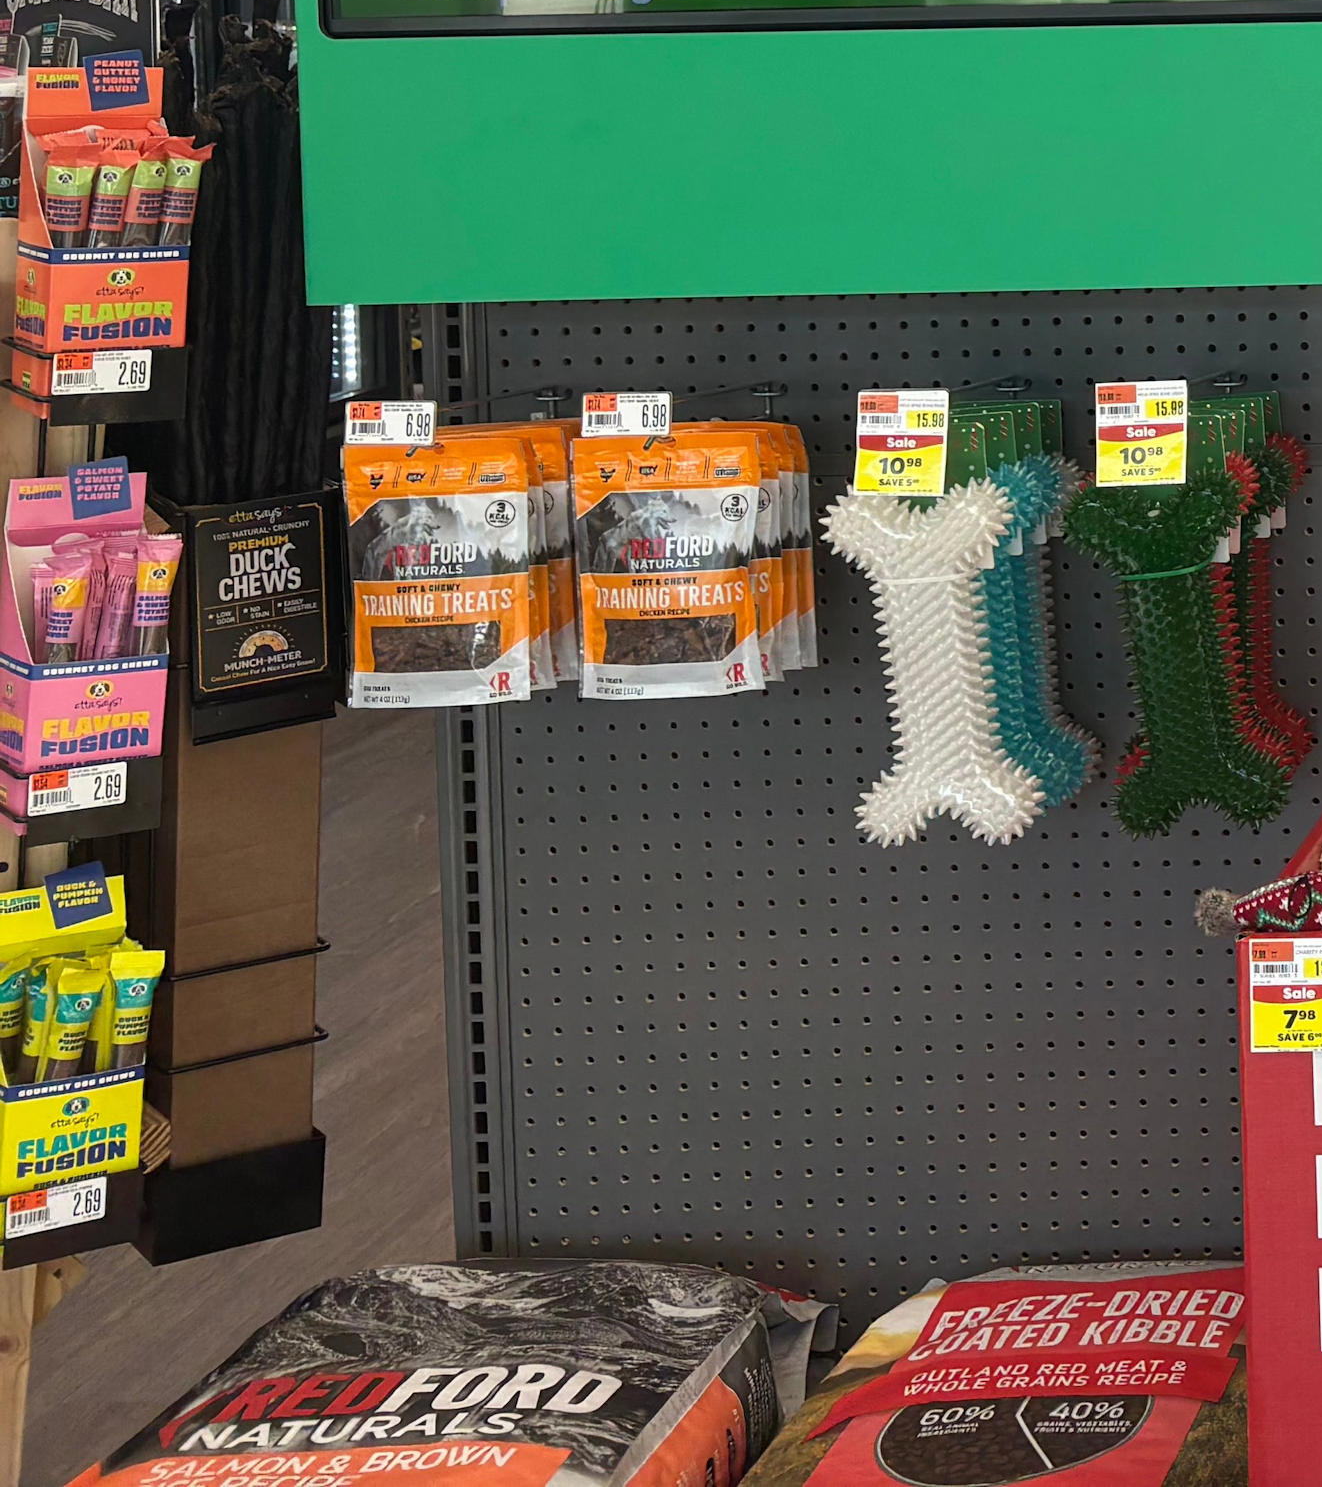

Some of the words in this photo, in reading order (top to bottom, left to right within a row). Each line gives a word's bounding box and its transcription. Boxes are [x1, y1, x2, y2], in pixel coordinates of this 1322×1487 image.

[64, 302, 173, 324] FLAVOR
[63, 317, 172, 342] FUSION
[118, 358, 146, 386] 2.69
[406, 415, 430, 438] 6.98
[917, 413, 944, 428] 15.98
[887, 437, 916, 449] Sale
[230, 543, 296, 576] DUCK
[219, 567, 301, 601] CHEWS
[363, 593, 435, 617] TRAINING
[443, 588, 513, 614] TREATS
[1283, 987, 1315, 1000] Sale
[73, 1190, 101, 1218] 2.69
[928, 1290, 1245, 1342] FREEZE-DRIED
[908, 1323, 1075, 1362] COATED
[1080, 1320, 1232, 1349] KIBBLE
[903, 1379, 991, 1398] WHOLE
[997, 1376, 1091, 1391] GRAINS
[1097, 1373, 1183, 1387] RECIPE
[911, 1364, 1035, 1385] OUTLAND
[1040, 1363, 1089, 1376] RED
[1095, 1360, 1170, 1374] MEAT
[1174, 1360, 1188, 1372] &
[209, 1365, 622, 1423] REDFORD
[178, 1413, 522, 1452] NATURALS
